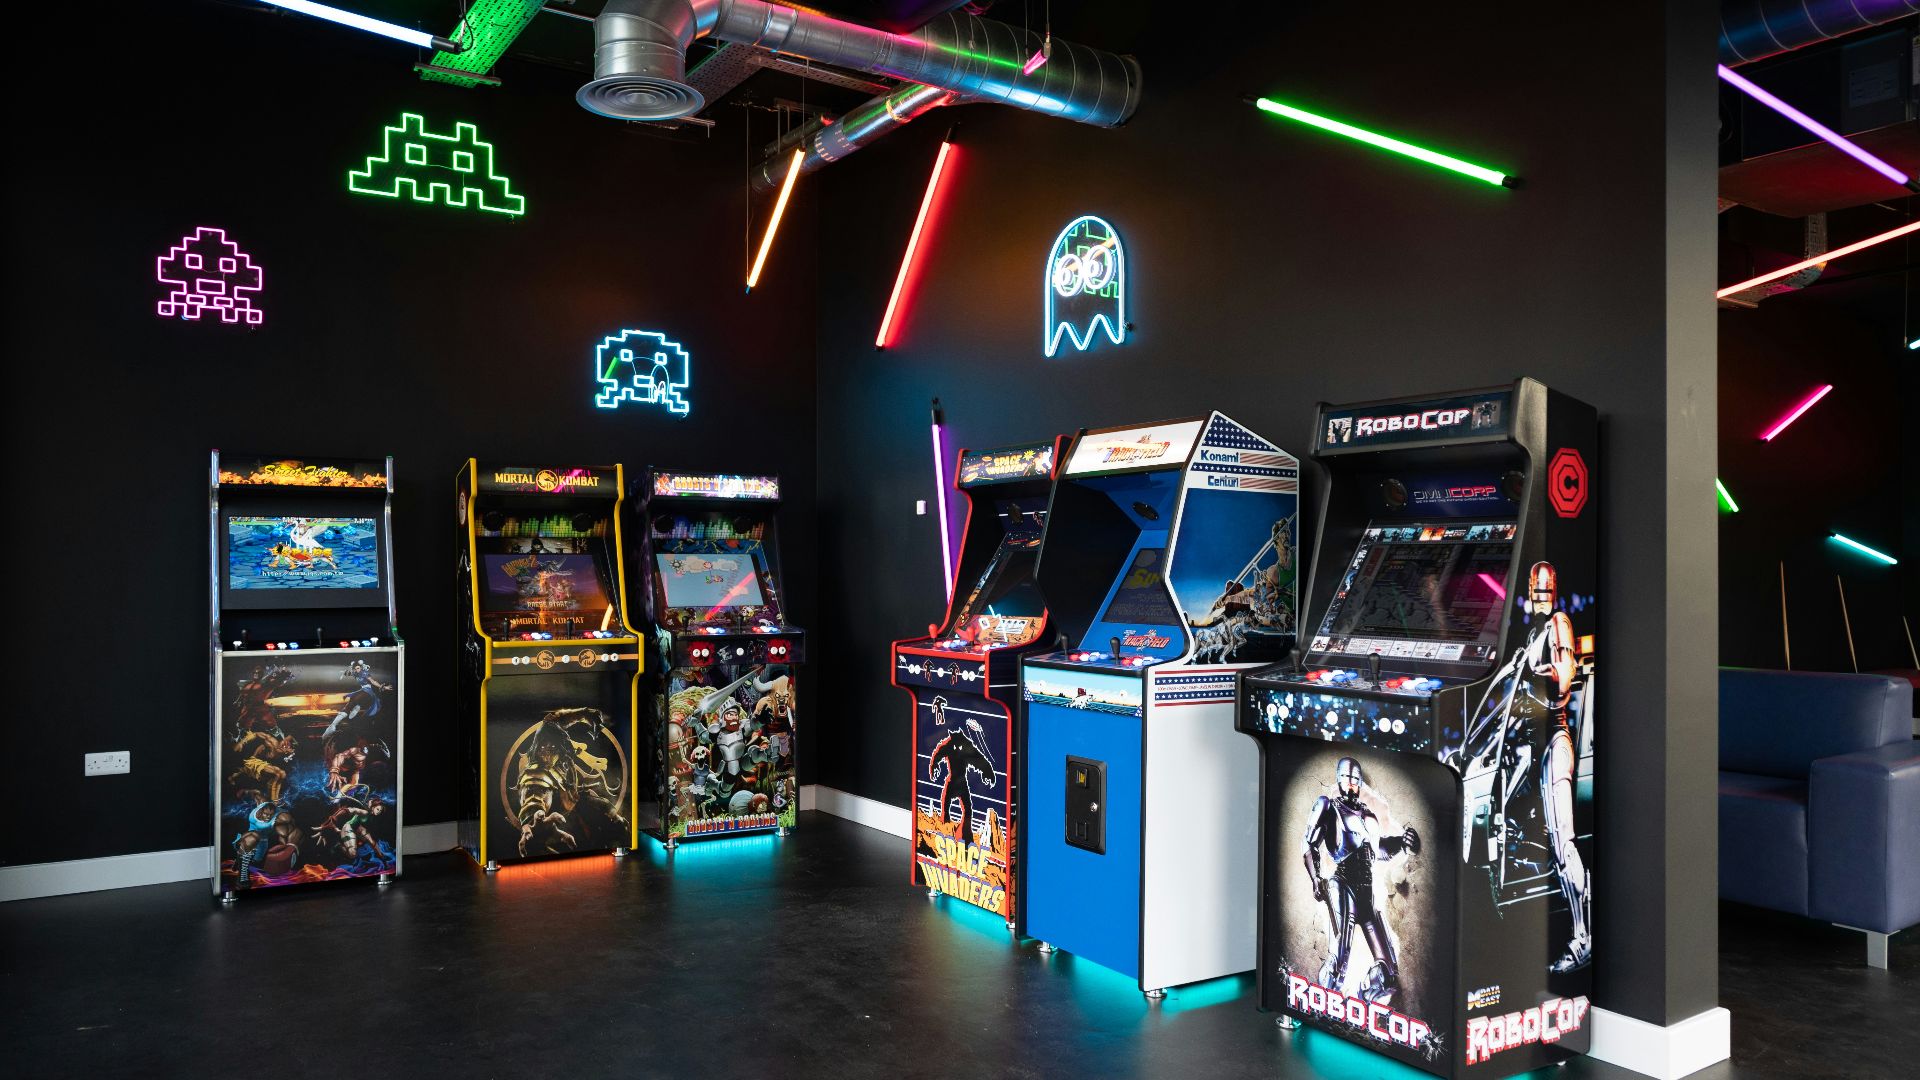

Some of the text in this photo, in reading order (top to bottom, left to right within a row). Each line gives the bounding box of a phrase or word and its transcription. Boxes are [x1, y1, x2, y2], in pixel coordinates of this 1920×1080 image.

[994, 454, 1023, 467] SPACE
[1201, 449, 1239, 463] Konami
[264, 464, 348, 479] Street Fighter
[494, 472, 600, 487] MORTAL KOMBAT
[935, 832, 992, 879] SPACE
[918, 860, 1006, 913] INVADERS
[1480, 985, 1501, 998] DATA
[1480, 994, 1501, 1008] EAST
